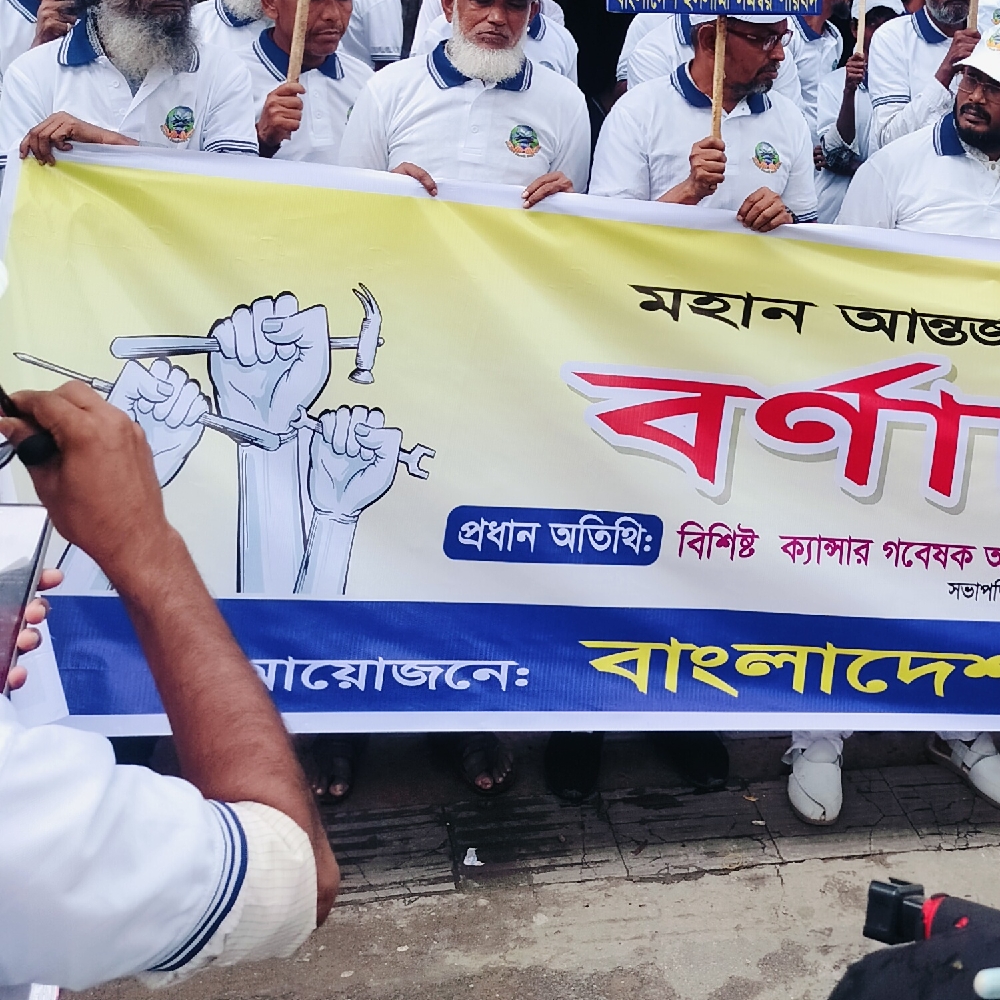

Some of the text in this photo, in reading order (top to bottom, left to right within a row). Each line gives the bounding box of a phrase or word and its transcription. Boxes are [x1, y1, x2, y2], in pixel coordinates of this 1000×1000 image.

[628, 283, 818, 336] মহান
[456, 517, 542, 553] প্রধান
[547, 513, 655, 557] অতিথি:
[675, 520, 760, 562] বিশিষ্ট
[778, 534, 875, 568] ক্যান্সার
[882, 539, 978, 575] গবেষক
